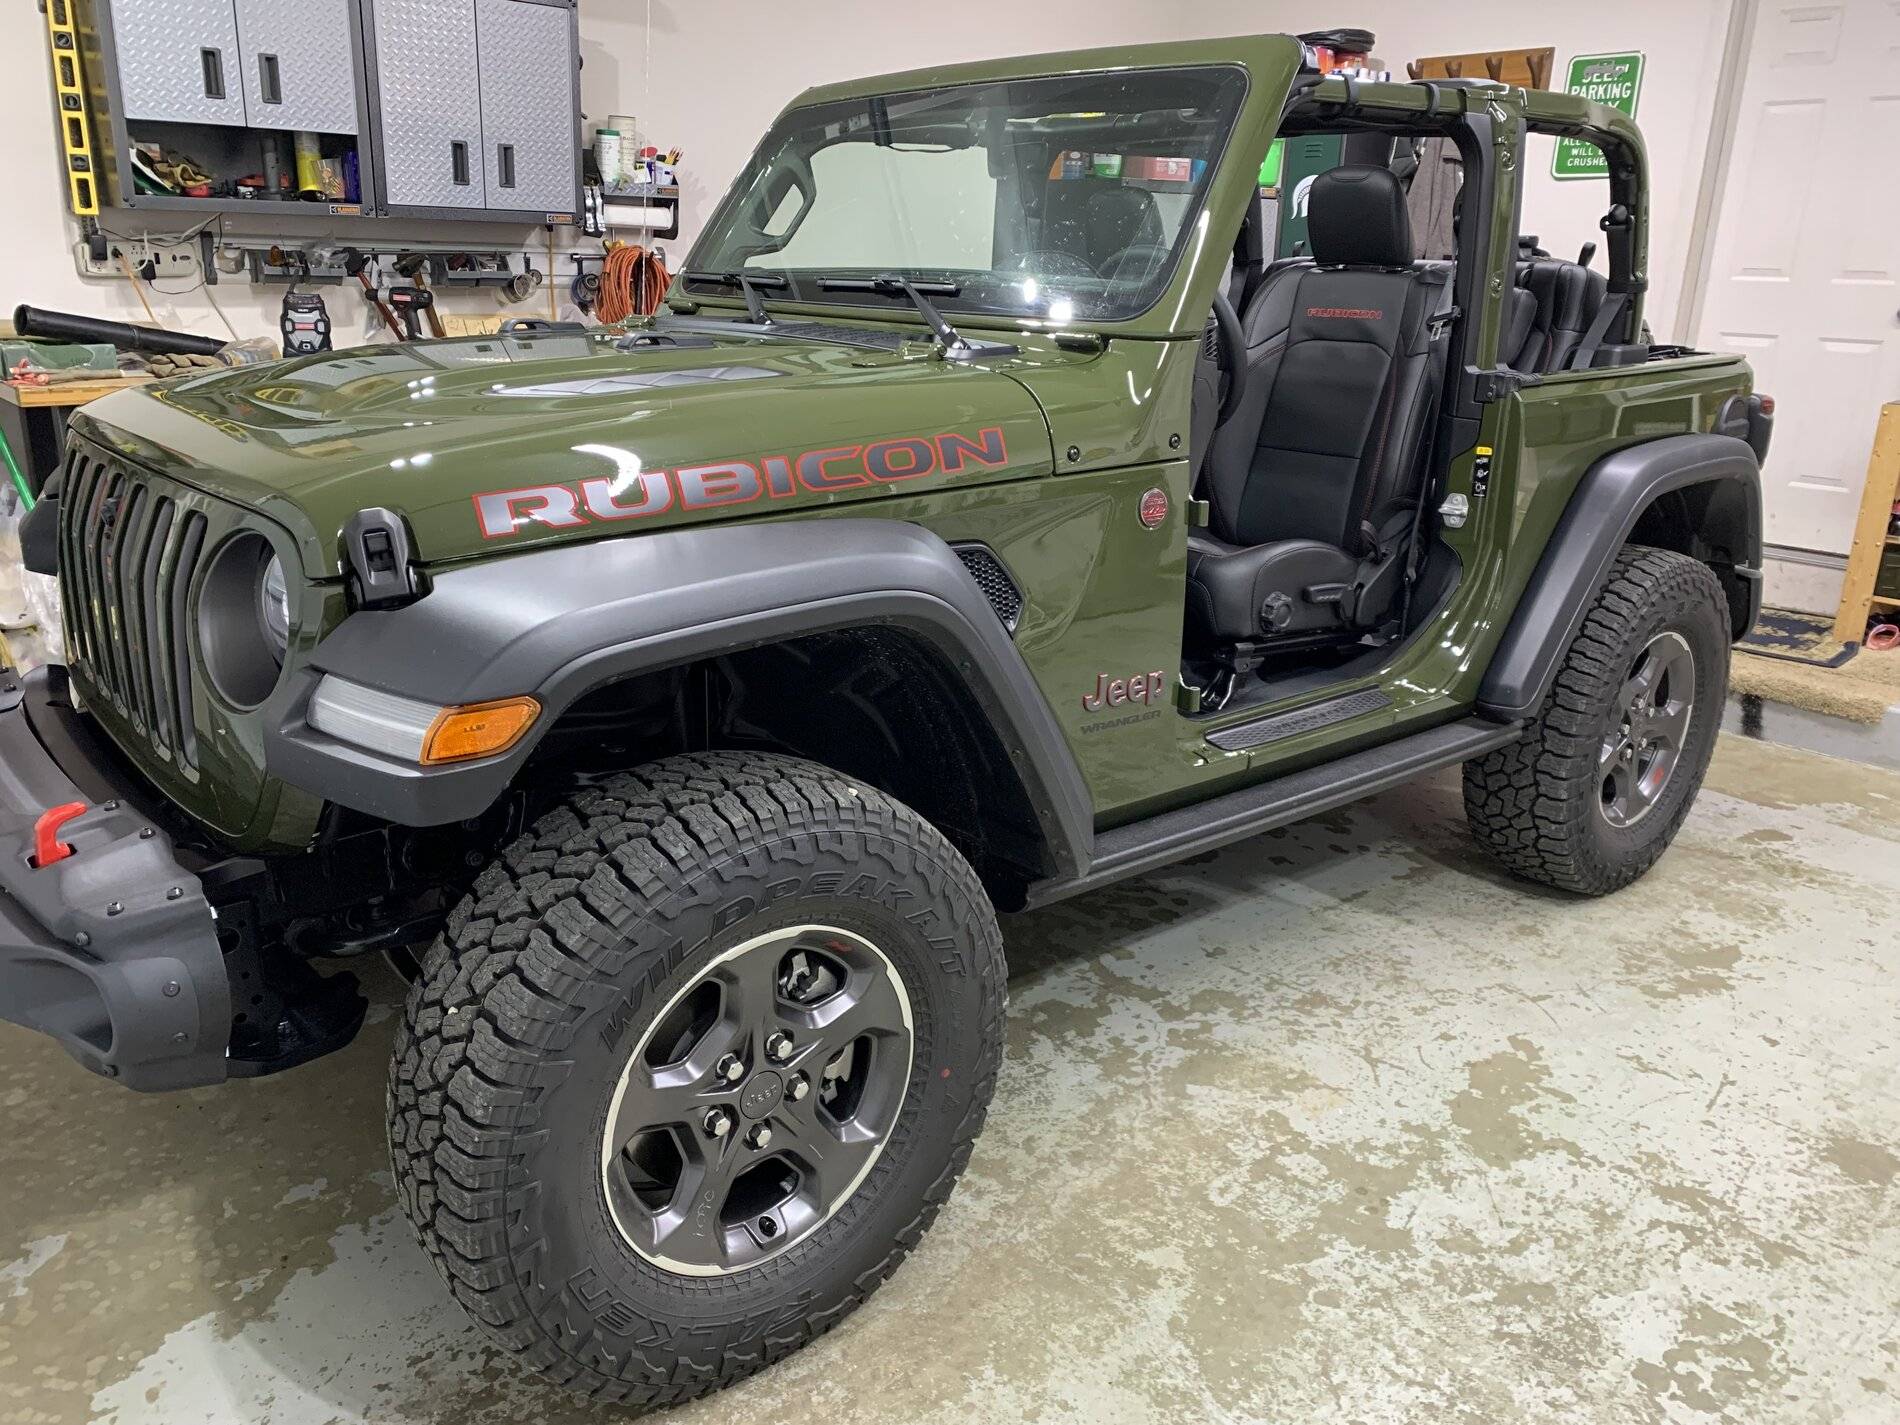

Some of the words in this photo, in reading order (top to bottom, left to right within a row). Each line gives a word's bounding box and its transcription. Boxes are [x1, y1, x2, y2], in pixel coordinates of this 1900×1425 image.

[1571, 82, 1632, 100] PARKING
[1567, 157, 1608, 167] CRUSHE
[1571, 147, 1594, 156] WILL
[472, 427, 1007, 539] RUBICON
[1083, 670, 1166, 712] Jeep
[600, 870, 914, 1054] WILDPEAK
